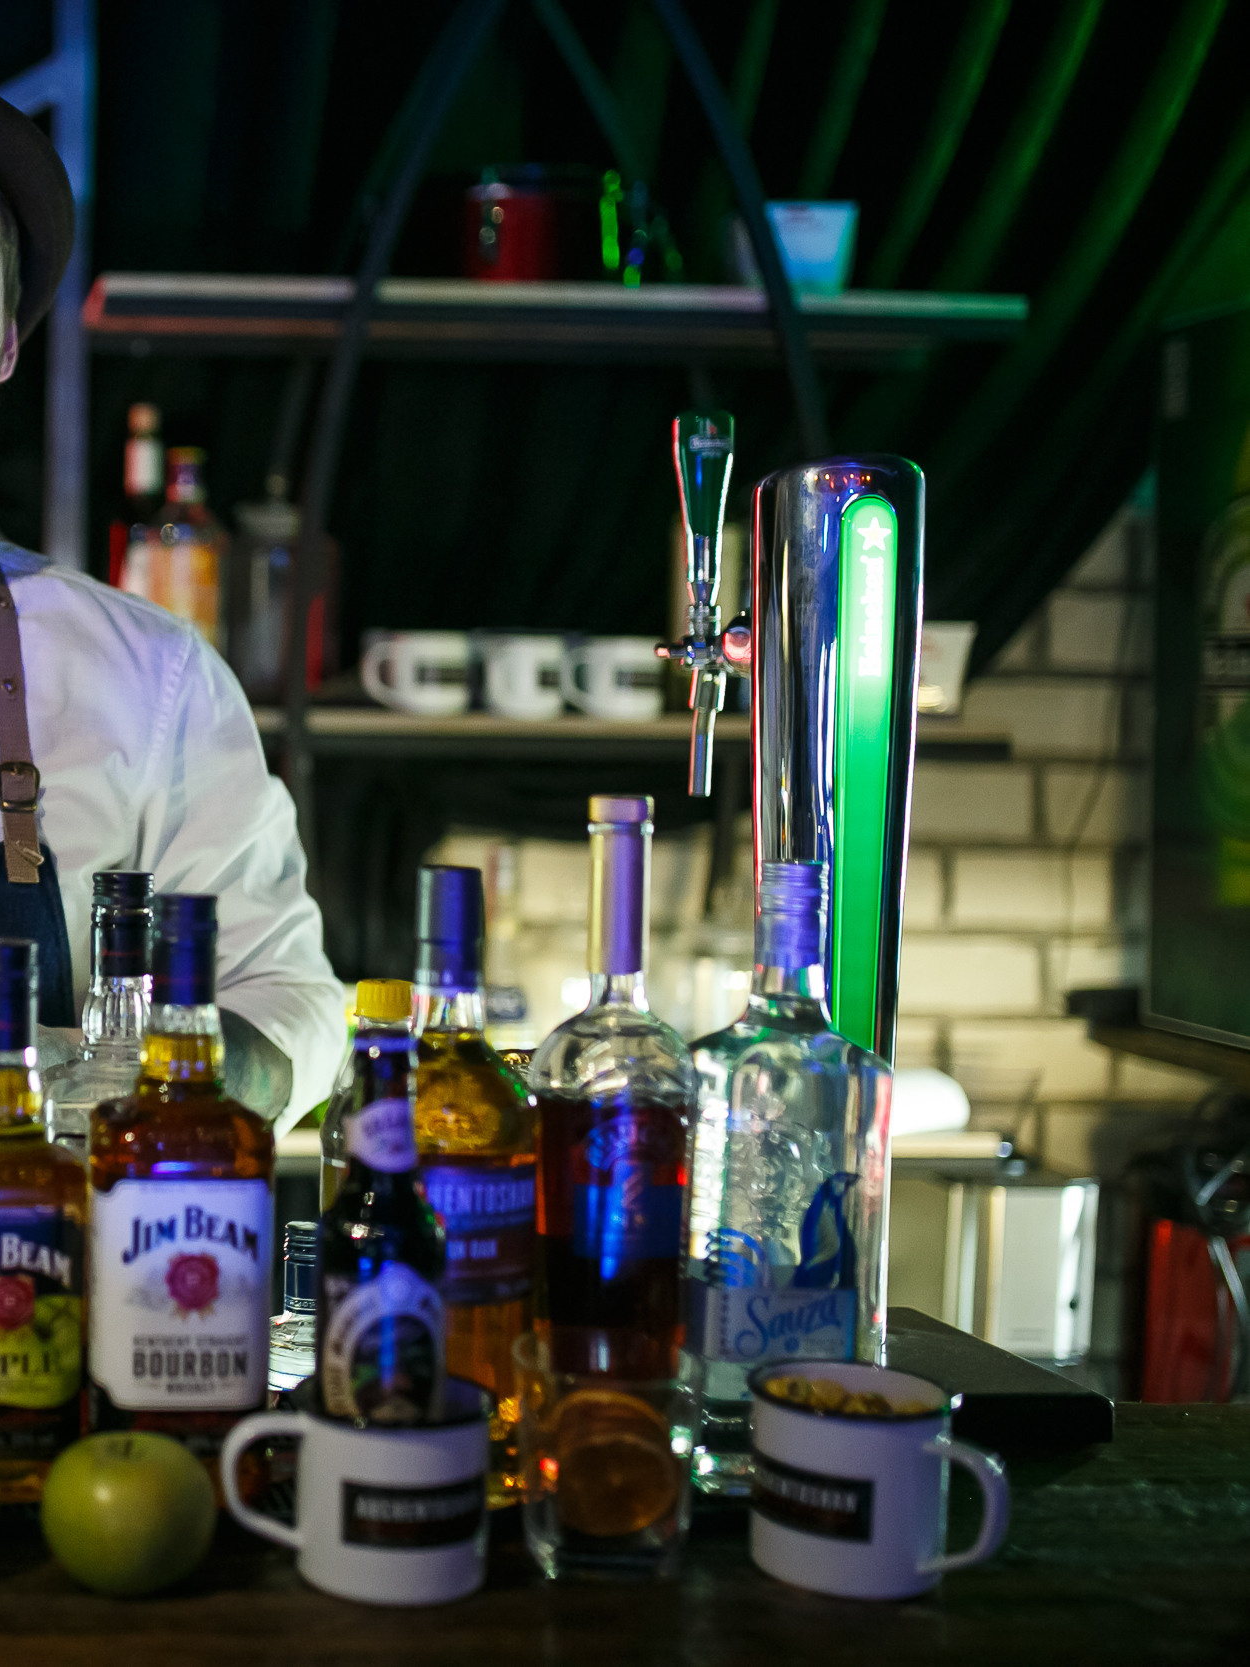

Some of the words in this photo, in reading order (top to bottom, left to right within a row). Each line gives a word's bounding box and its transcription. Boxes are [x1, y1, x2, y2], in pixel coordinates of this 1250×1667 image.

[0, 1231, 72, 1290] BEAM
[121, 1215, 177, 1264] JIM
[184, 1204, 259, 1263] BEAM
[734, 1293, 842, 1358] Sauza
[133, 1351, 248, 1378] BOURBON
